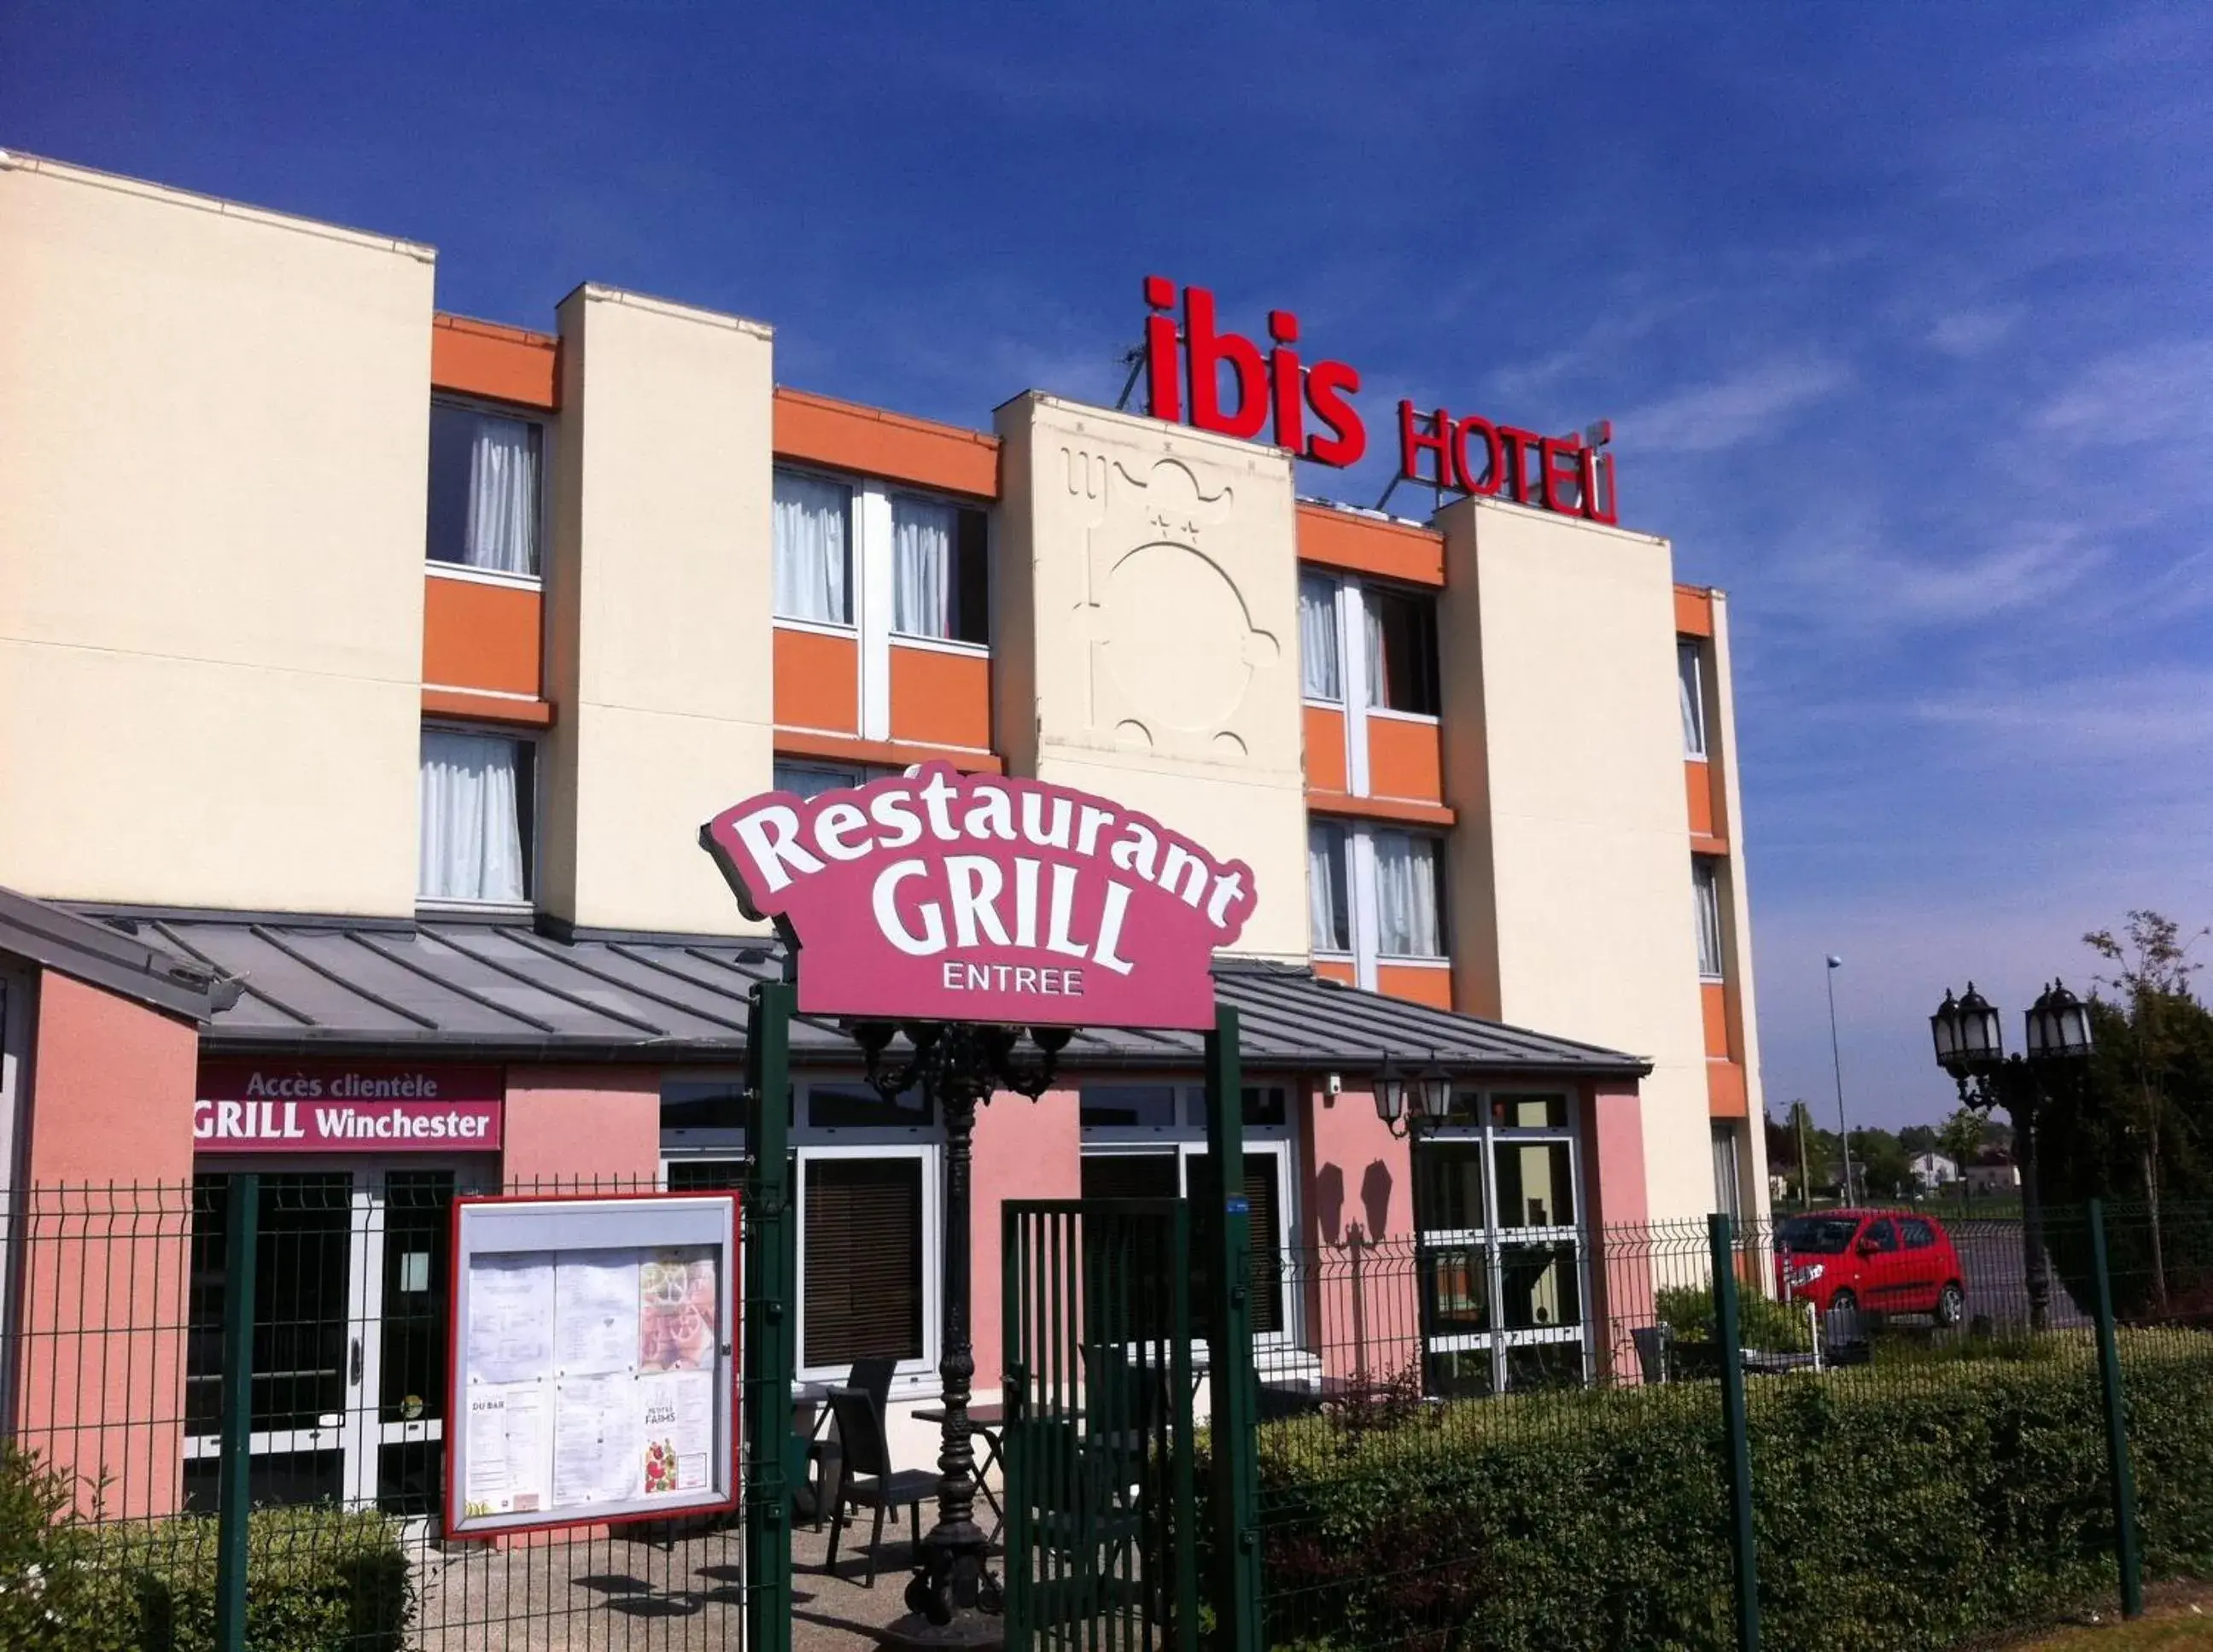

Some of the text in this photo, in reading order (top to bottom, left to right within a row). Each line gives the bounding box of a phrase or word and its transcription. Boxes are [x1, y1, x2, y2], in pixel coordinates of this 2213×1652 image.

[1144, 275, 1366, 468] ibis
[1398, 400, 1617, 526] HOTEL
[732, 773, 1246, 928] Restaurant
[872, 855, 1134, 975] GRILL
[943, 962, 1084, 996] ENTREE
[193, 1100, 490, 1139] GRILL Winchester
[247, 1072, 437, 1097] Accès clientèle
